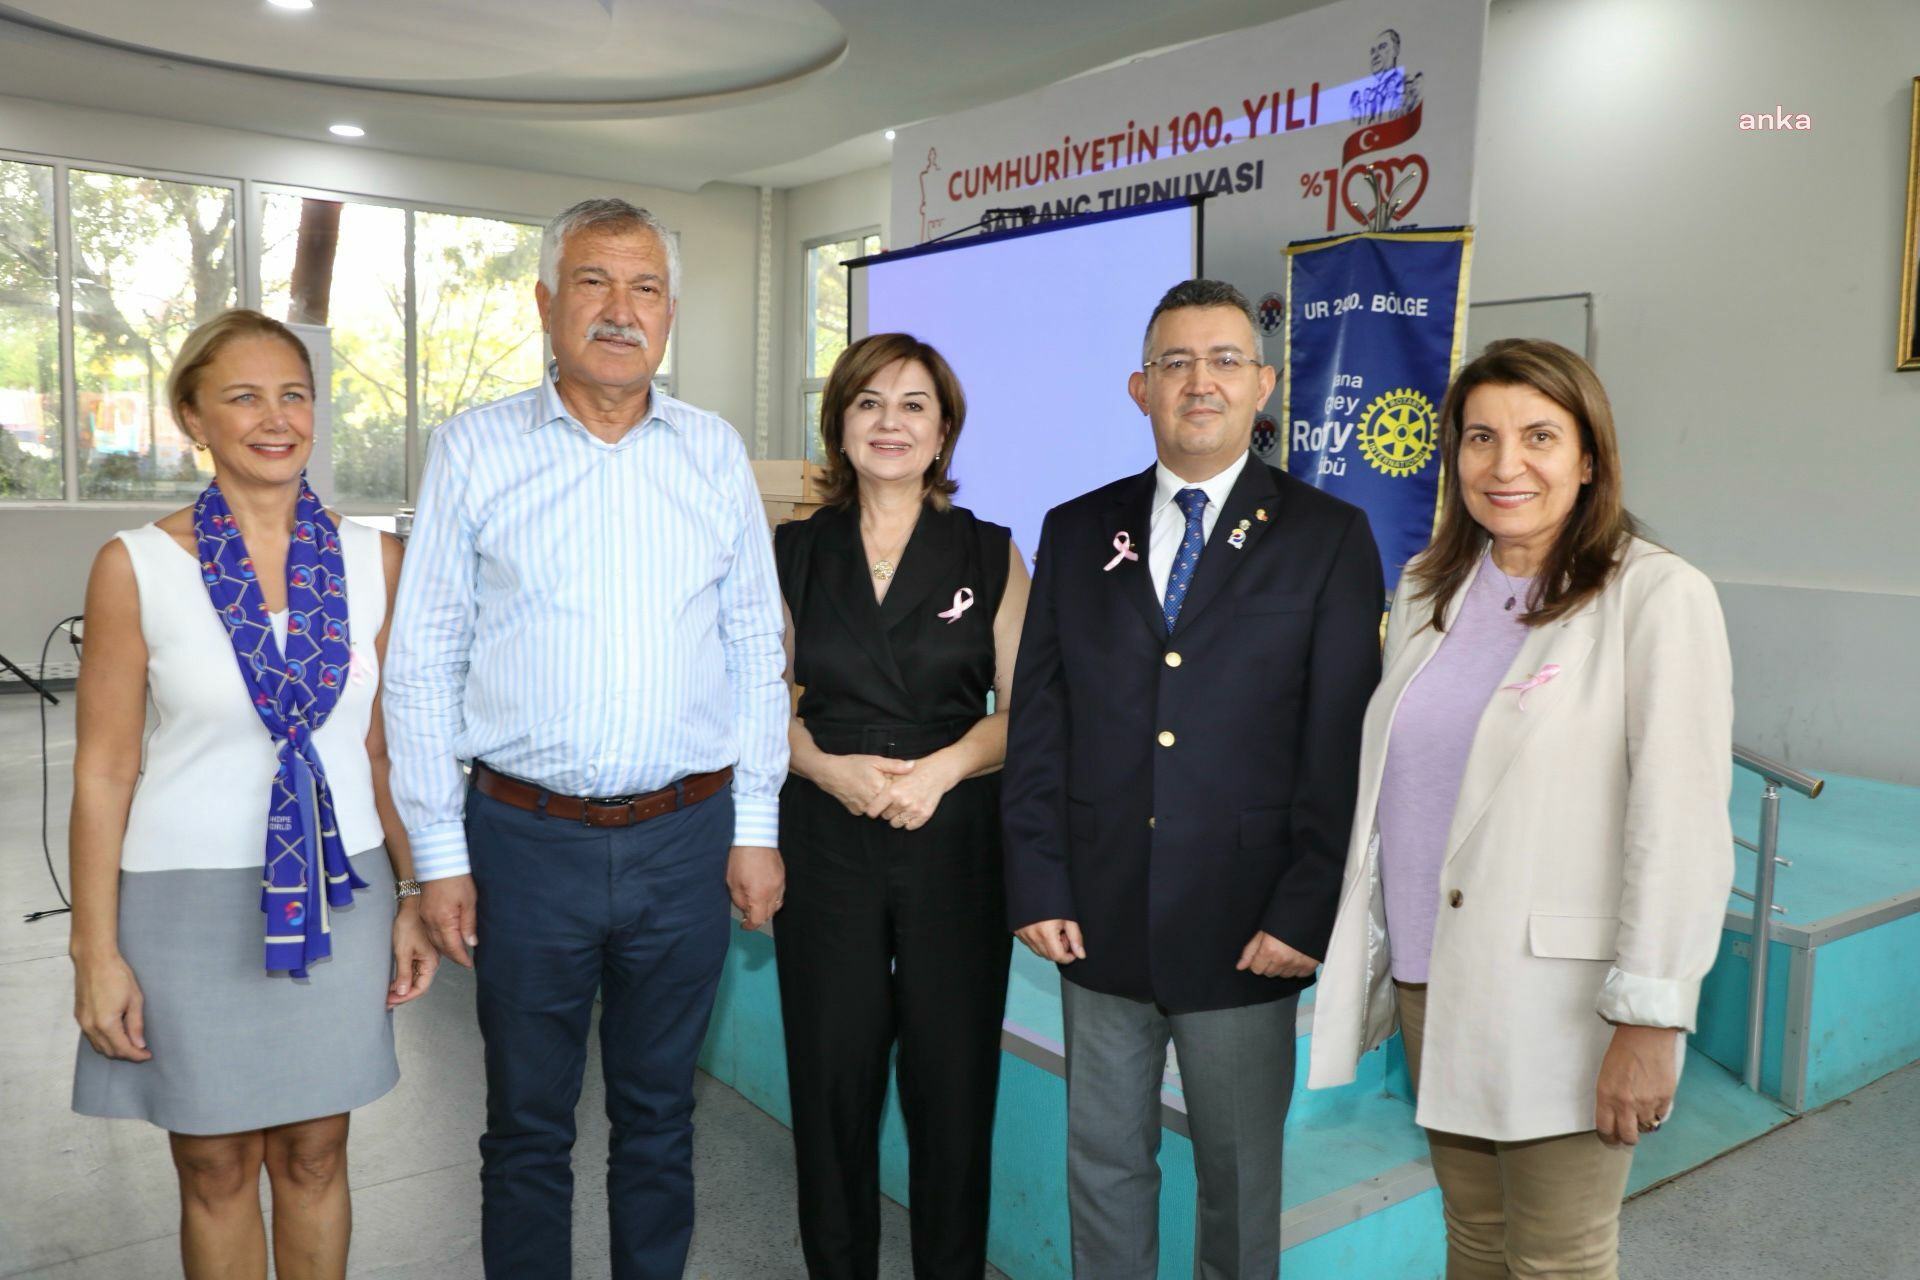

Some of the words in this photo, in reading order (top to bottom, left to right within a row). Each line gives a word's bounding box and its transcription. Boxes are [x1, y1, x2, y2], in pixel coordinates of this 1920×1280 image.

[948, 119, 1160, 201] CUMHURİYETİN
[1168, 106, 1233, 156] 100.
[1242, 81, 1320, 139] YILI
[1304, 301, 1330, 320] UR
[1371, 291, 1429, 317] BÖLGE
